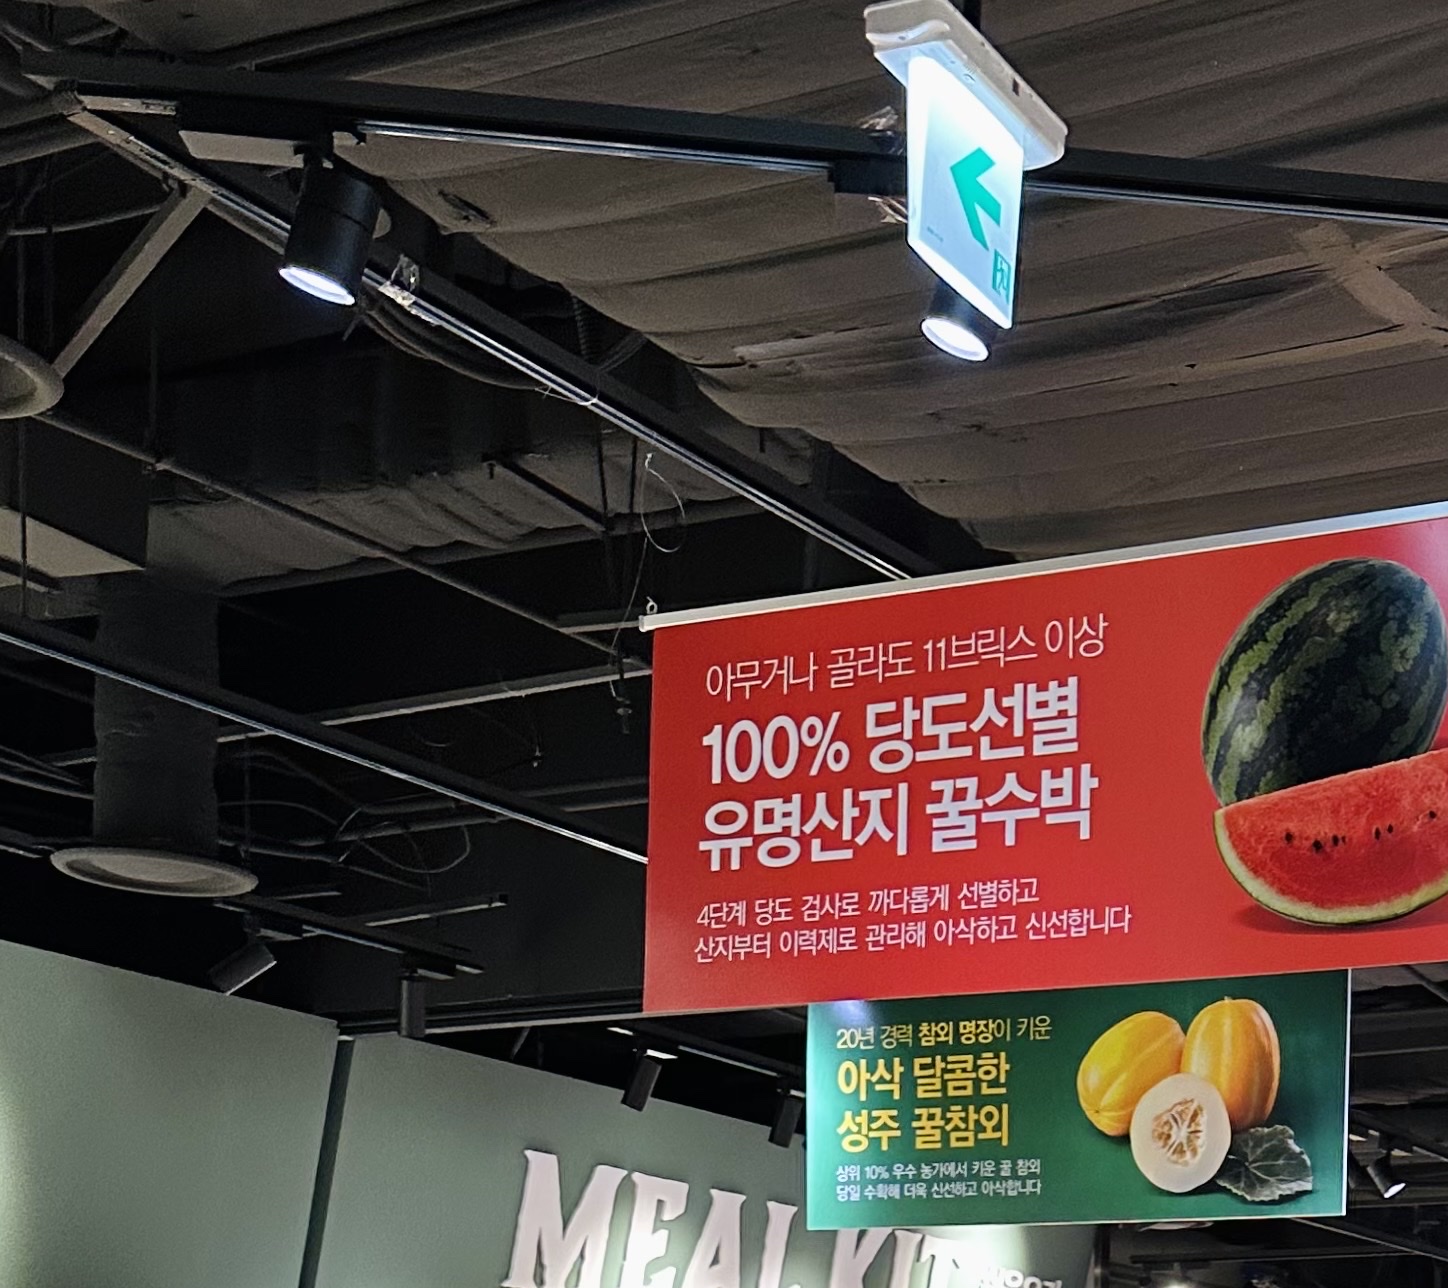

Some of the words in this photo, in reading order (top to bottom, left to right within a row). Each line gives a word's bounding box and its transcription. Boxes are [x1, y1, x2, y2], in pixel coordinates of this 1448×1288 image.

[705, 653, 818, 701] 아무거나
[827, 641, 914, 689] 골라도
[924, 626, 1038, 672] 11브릭스
[1045, 614, 1108, 659] 이상
[702, 711, 849, 784] 100%
[866, 676, 1079, 773] 당도선별
[699, 782, 909, 871] 유명산지
[926, 764, 1098, 853] 꿀수박
[697, 900, 746, 929] 4단계
[754, 896, 793, 926] 당도
[801, 893, 860, 921] 검사로
[868, 884, 949, 916] 까다롭게
[957, 878, 1039, 909] 선별하고
[694, 932, 771, 963] 산지부터
[779, 925, 857, 957] 이력제로
[865, 922, 926, 951] 관리해
[934, 914, 1018, 945] 아삭하고
[1025, 905, 1131, 939] 신선합니다
[836, 1027, 875, 1049] 20년
[880, 1024, 913, 1049] 경력
[918, 1021, 954, 1047] 참외
[959, 1018, 1011, 1045] 명장이
[1017, 1015, 1052, 1040] 키운
[837, 1057, 904, 1101] 아삭
[913, 1052, 1010, 1099] 달콤한
[836, 1109, 901, 1153] 성주
[911, 1103, 1009, 1149] 꿀참외
[836, 1165, 860, 1182] 상위
[864, 1165, 889, 1180] 10%
[892, 1163, 917, 1180] 우수
[920, 1160, 968, 1179] 농가에서
[972, 1160, 996, 1177] 키운
[1016, 1158, 1040, 1176] 참외
[836, 1184, 860, 1202] 당일
[904, 1183, 928, 1198] 더욱
[931, 1181, 977, 1198] 신선하고
[981, 1179, 1041, 1197] 아삭합니다
